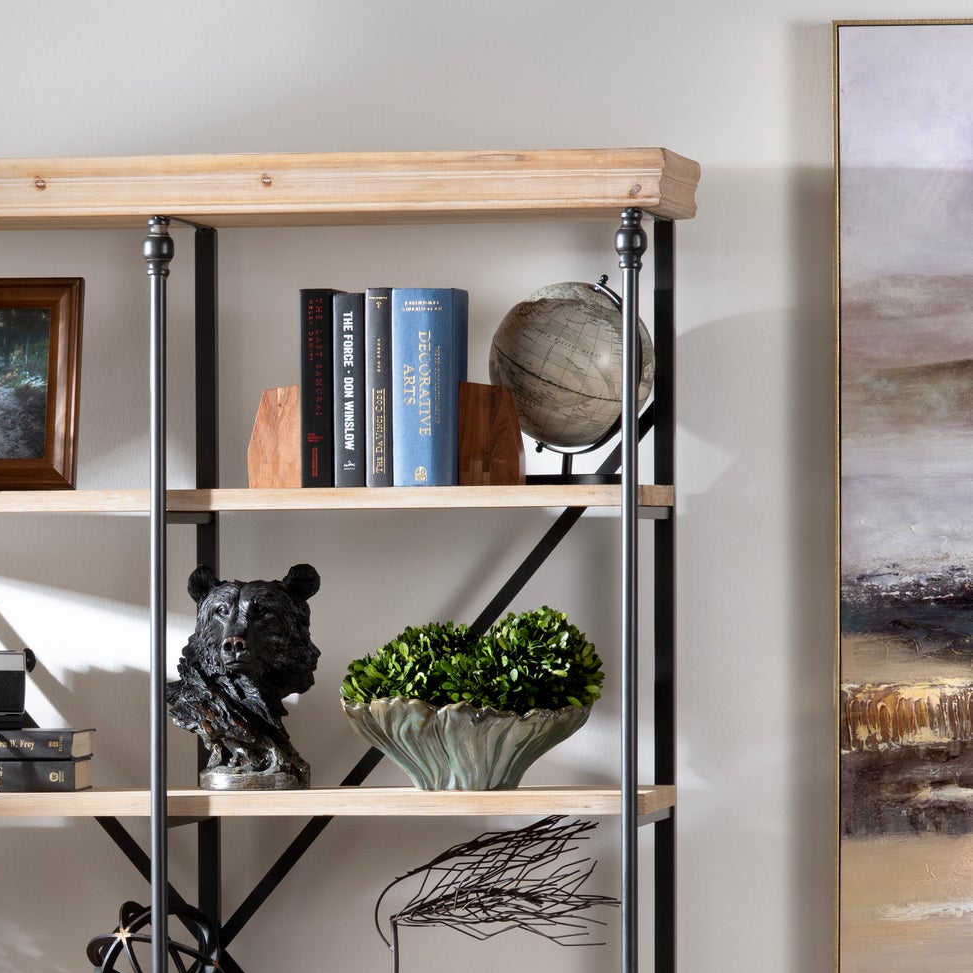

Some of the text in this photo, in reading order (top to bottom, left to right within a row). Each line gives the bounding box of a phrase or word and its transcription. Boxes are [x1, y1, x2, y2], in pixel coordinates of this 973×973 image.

[343, 311, 354, 331] THE
[315, 298, 323, 417] THE LAST SAMURAI
[343, 334, 354, 367] FORCE
[343, 376, 355, 398] DON
[403, 364, 415, 406] ARTS
[419, 330, 431, 437] DECORATIVE
[344, 400, 355, 450] WINSLOW
[19, 739, 35, 750] Frey
